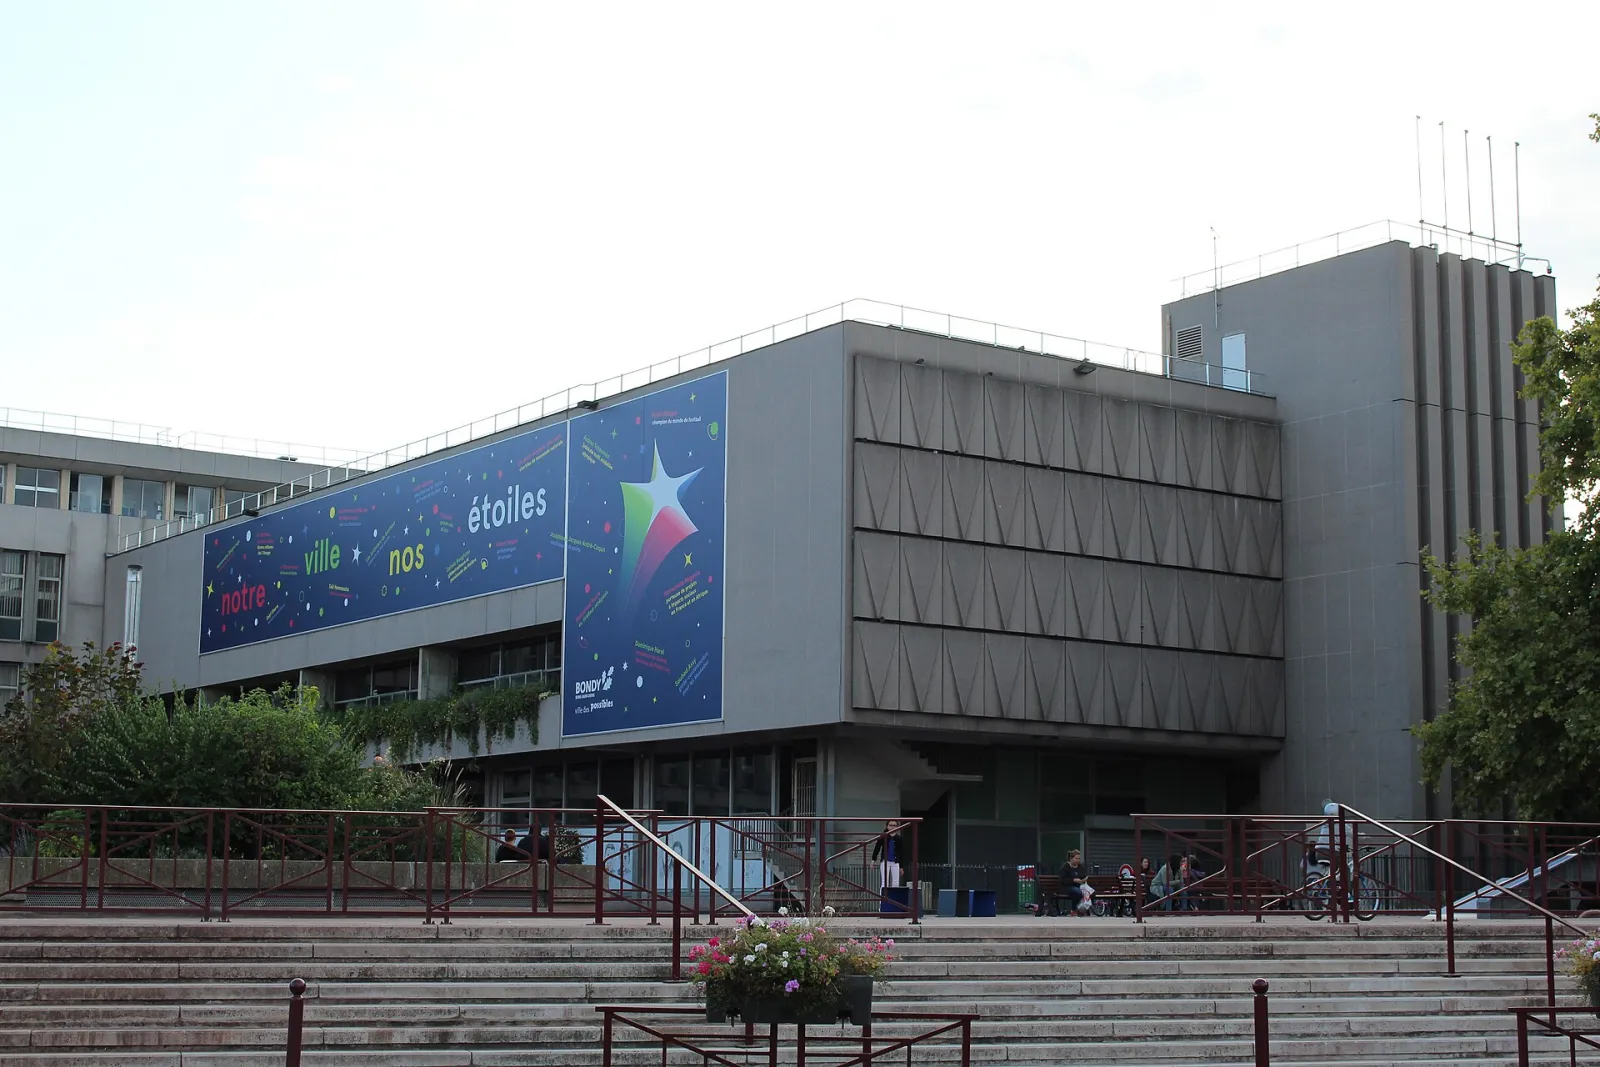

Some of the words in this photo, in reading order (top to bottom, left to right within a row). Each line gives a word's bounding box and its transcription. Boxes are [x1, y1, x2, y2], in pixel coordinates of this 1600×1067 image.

[468, 484, 547, 534] étoiles
[304, 538, 340, 576] ville
[389, 543, 424, 576] nos
[221, 582, 266, 616] notre
[576, 678, 601, 694] BONDY
[590, 699, 614, 712] possibles
